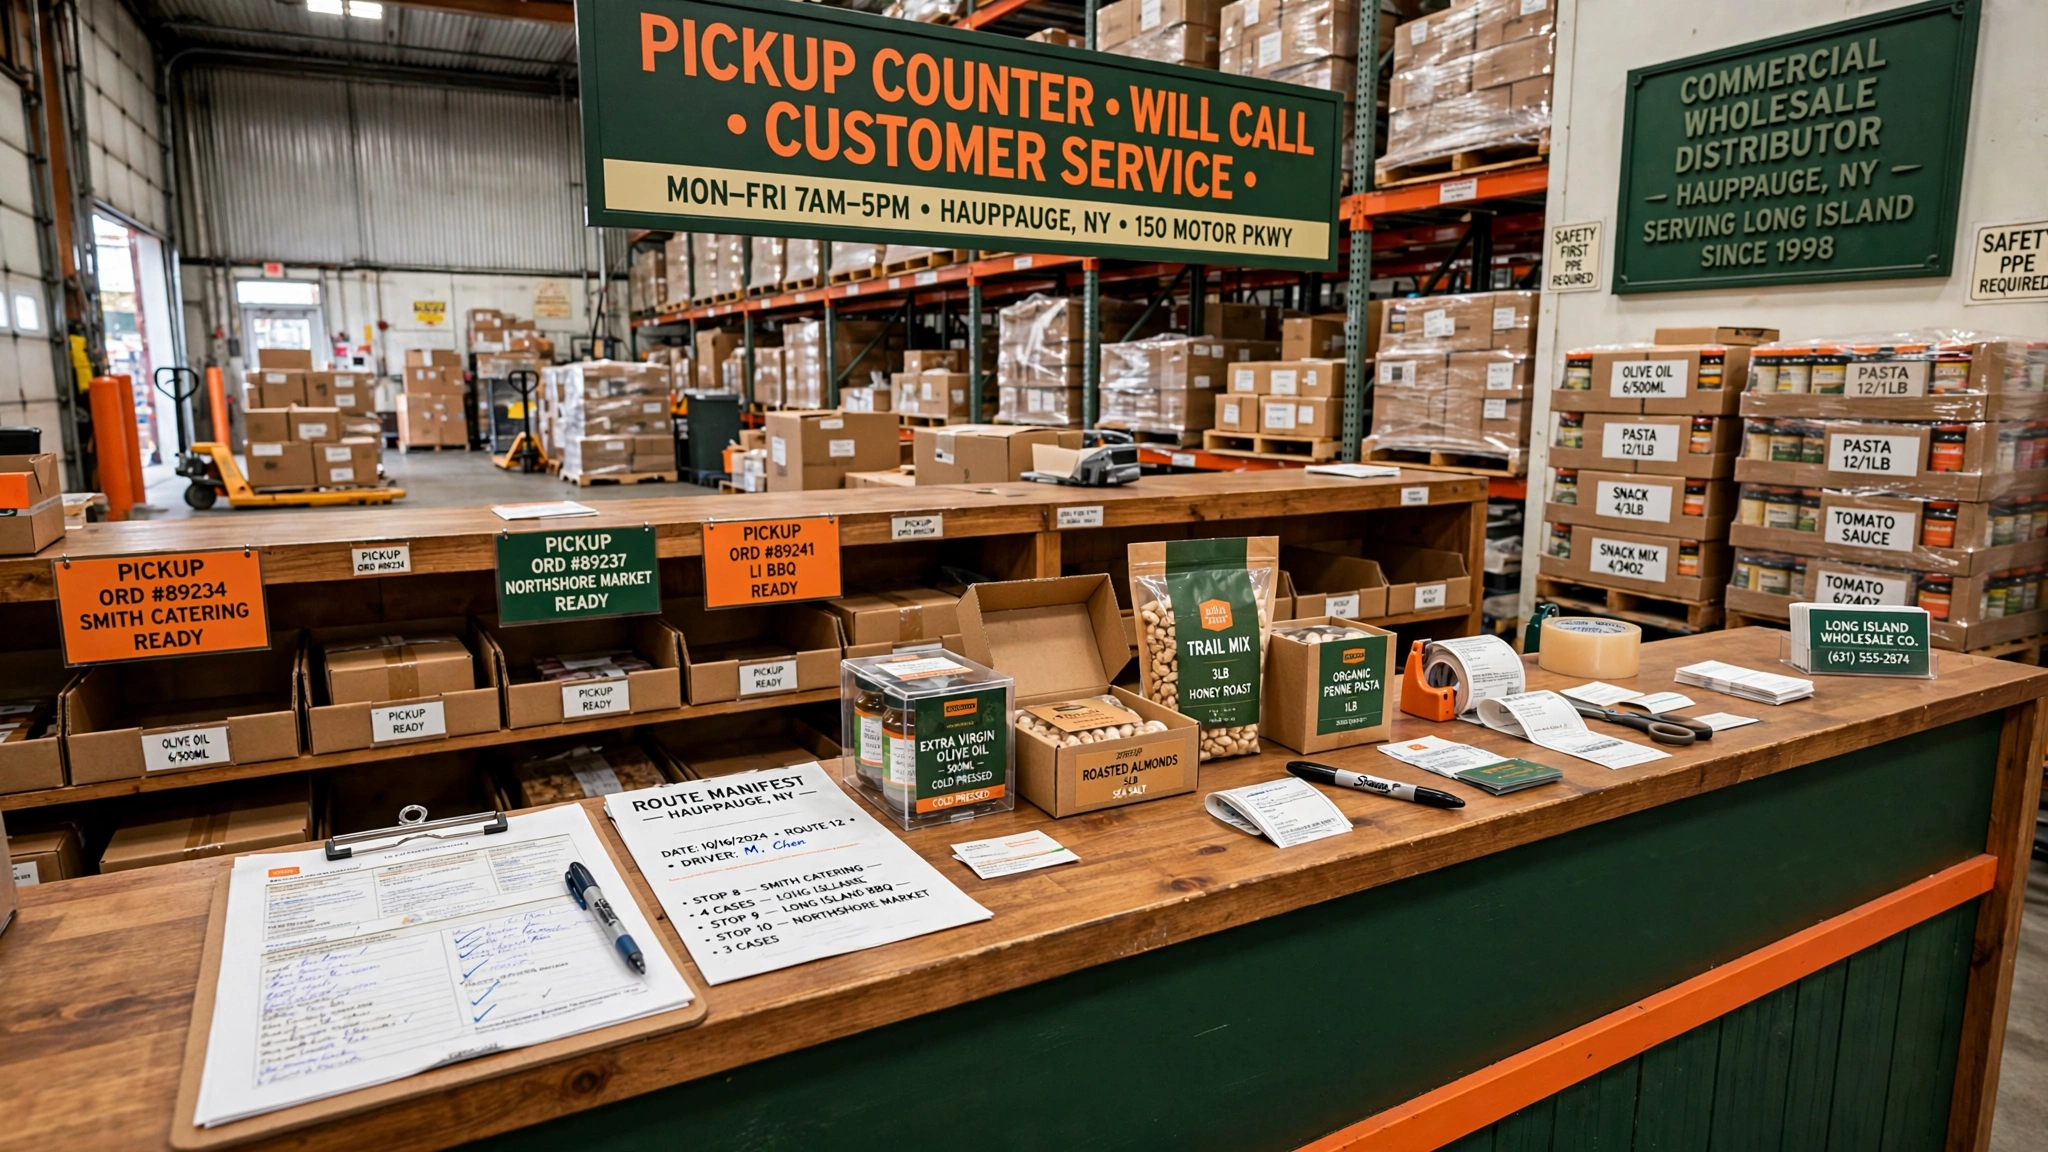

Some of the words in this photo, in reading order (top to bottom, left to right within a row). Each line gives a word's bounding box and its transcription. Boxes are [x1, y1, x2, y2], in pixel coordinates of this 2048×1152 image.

[1681, 38, 1886, 104] COMMERCIAL
[640, 12, 856, 94] PICKUP
[872, 48, 1093, 127] COUNTER
[1129, 85, 1220, 144] WILL
[1229, 102, 1315, 156] CALL
[1684, 77, 1877, 138] WHOLESALE
[765, 100, 1046, 183] CUSTOMER
[1061, 137, 1233, 200] SERVICE
[1675, 116, 1882, 173] DISTRIBUTOR
[1676, 167, 1829, 207] HAUPPAUGE,
[1838, 159, 1880, 190] NY
[940, 198, 1078, 235] HAUPPAUGE,
[1083, 210, 1111, 235] NY
[1135, 215, 1167, 239] 150
[1172, 218, 1236, 245] MOTOR
[1241, 223, 1292, 249] PKWY
[1643, 211, 1736, 243] SERVING
[1742, 203, 1807, 234] LONG
[1815, 195, 1914, 227] ISLAND
[1555, 226, 1597, 245] SAFETY
[1983, 229, 2048, 253] SAFET
[1561, 244, 1589, 258] FIRST
[1701, 240, 1767, 267] SINCE
[1775, 235, 1834, 262] 1998
[2000, 254, 2036, 273] PPE
[1622, 366, 1652, 378] OLIVE
[1656, 365, 1673, 378] OIL
[1858, 366, 1909, 380] PASTA
[1857, 381, 1908, 395] 12/1LB
[1622, 428, 1657, 441] PASTA
[1622, 443, 1654, 456] 12/1LB
[1843, 439, 1892, 454] PASTA
[1843, 456, 1891, 471] 12/1LB
[1613, 487, 1649, 502] SNACK
[1614, 503, 1644, 516] 4/3LB
[1835, 511, 1895, 530] TOMATO
[743, 524, 802, 542] PICKUP
[1841, 529, 1890, 546] SAUCE
[544, 534, 612, 553] PICKUP
[729, 546, 761, 562] ORD
[765, 543, 815, 560] #89241
[1600, 543, 1635, 560] SNACK
[1638, 549, 1659, 562] MIX
[361, 550, 400, 561] PICKUP
[531, 557, 567, 574] ORD
[570, 553, 627, 572] #89237
[118, 559, 204, 582] PICKUP
[750, 564, 763, 578] LI
[767, 562, 797, 579] BBQ
[505, 575, 597, 595] NORTHSHORE
[600, 570, 652, 588] MARKET
[751, 582, 798, 599] READY
[1826, 575, 1884, 595] TOMATO
[98, 587, 145, 606] ORD
[151, 582, 227, 602] #89234
[555, 593, 609, 612] READY
[80, 610, 144, 631] SMITH
[151, 602, 249, 625] CATERING
[1825, 620, 1859, 632] LONG
[1863, 621, 1909, 633] ISLAND
[134, 629, 204, 650] READY
[1187, 638, 1226, 657] TRAIL
[1229, 636, 1251, 653] MIX
[1820, 632, 1894, 645] WHOLESALE
[1897, 635, 1919, 647] CO.
[1828, 651, 1855, 665] (631)
[753, 665, 784, 678] PICKUP
[1212, 667, 1229, 680] 3LB
[1332, 668, 1371, 682] ORGANIC
[578, 686, 613, 698] PICKUP
[755, 677, 782, 689] READY
[1189, 686, 1221, 700] HONEY
[1223, 683, 1252, 696] ROAST
[1324, 683, 1352, 698] PENNE
[1354, 679, 1380, 695] PASTA
[582, 699, 612, 711] READY
[1344, 701, 1358, 713] 1LB
[388, 708, 426, 721] PICKUP
[393, 721, 425, 734] READY
[162, 735, 190, 749] OLIVE
[193, 734, 210, 746] OIL
[920, 736, 956, 752] EXTRA
[958, 730, 995, 746] VIRGIN
[937, 747, 969, 762] OLIVE
[971, 744, 989, 756] OIL
[1083, 763, 1128, 781] ROASTED
[1130, 754, 1178, 774] ALMONDS
[931, 777, 954, 790] COLD
[632, 791, 704, 812] ROUTE
[707, 775, 805, 801] MANIFEST
[932, 797, 954, 807] COLD
[668, 795, 771, 819] HAUPPAUGE,
[772, 791, 794, 802] NY
[661, 845, 700, 858] DATE:
[701, 832, 768, 851] 10/16/2024
[784, 822, 827, 836] ROUTE
[828, 818, 845, 830] 12
[744, 845, 765, 856] M.
[772, 839, 806, 850] Chen
[680, 851, 739, 868] DRIVER:
[692, 891, 728, 905] STOP
[733, 889, 741, 897] 8
[760, 878, 801, 892] SMITH
[802, 863, 864, 882] CATERING
[700, 908, 710, 916] 4
[713, 900, 756, 915] CASES
[710, 914, 747, 929] STOP
[752, 911, 760, 920] 9
[781, 899, 819, 913] LONG
[819, 889, 865, 906] ISLAND
[865, 883, 894, 895] BBQ
[716, 928, 752, 942] STOP
[757, 922, 773, 933] 10
[792, 901, 878, 925] NORTHSHORE
[879, 889, 930, 906] MARKET
[724, 945, 733, 954] 3
[735, 935, 780, 951] CASES
